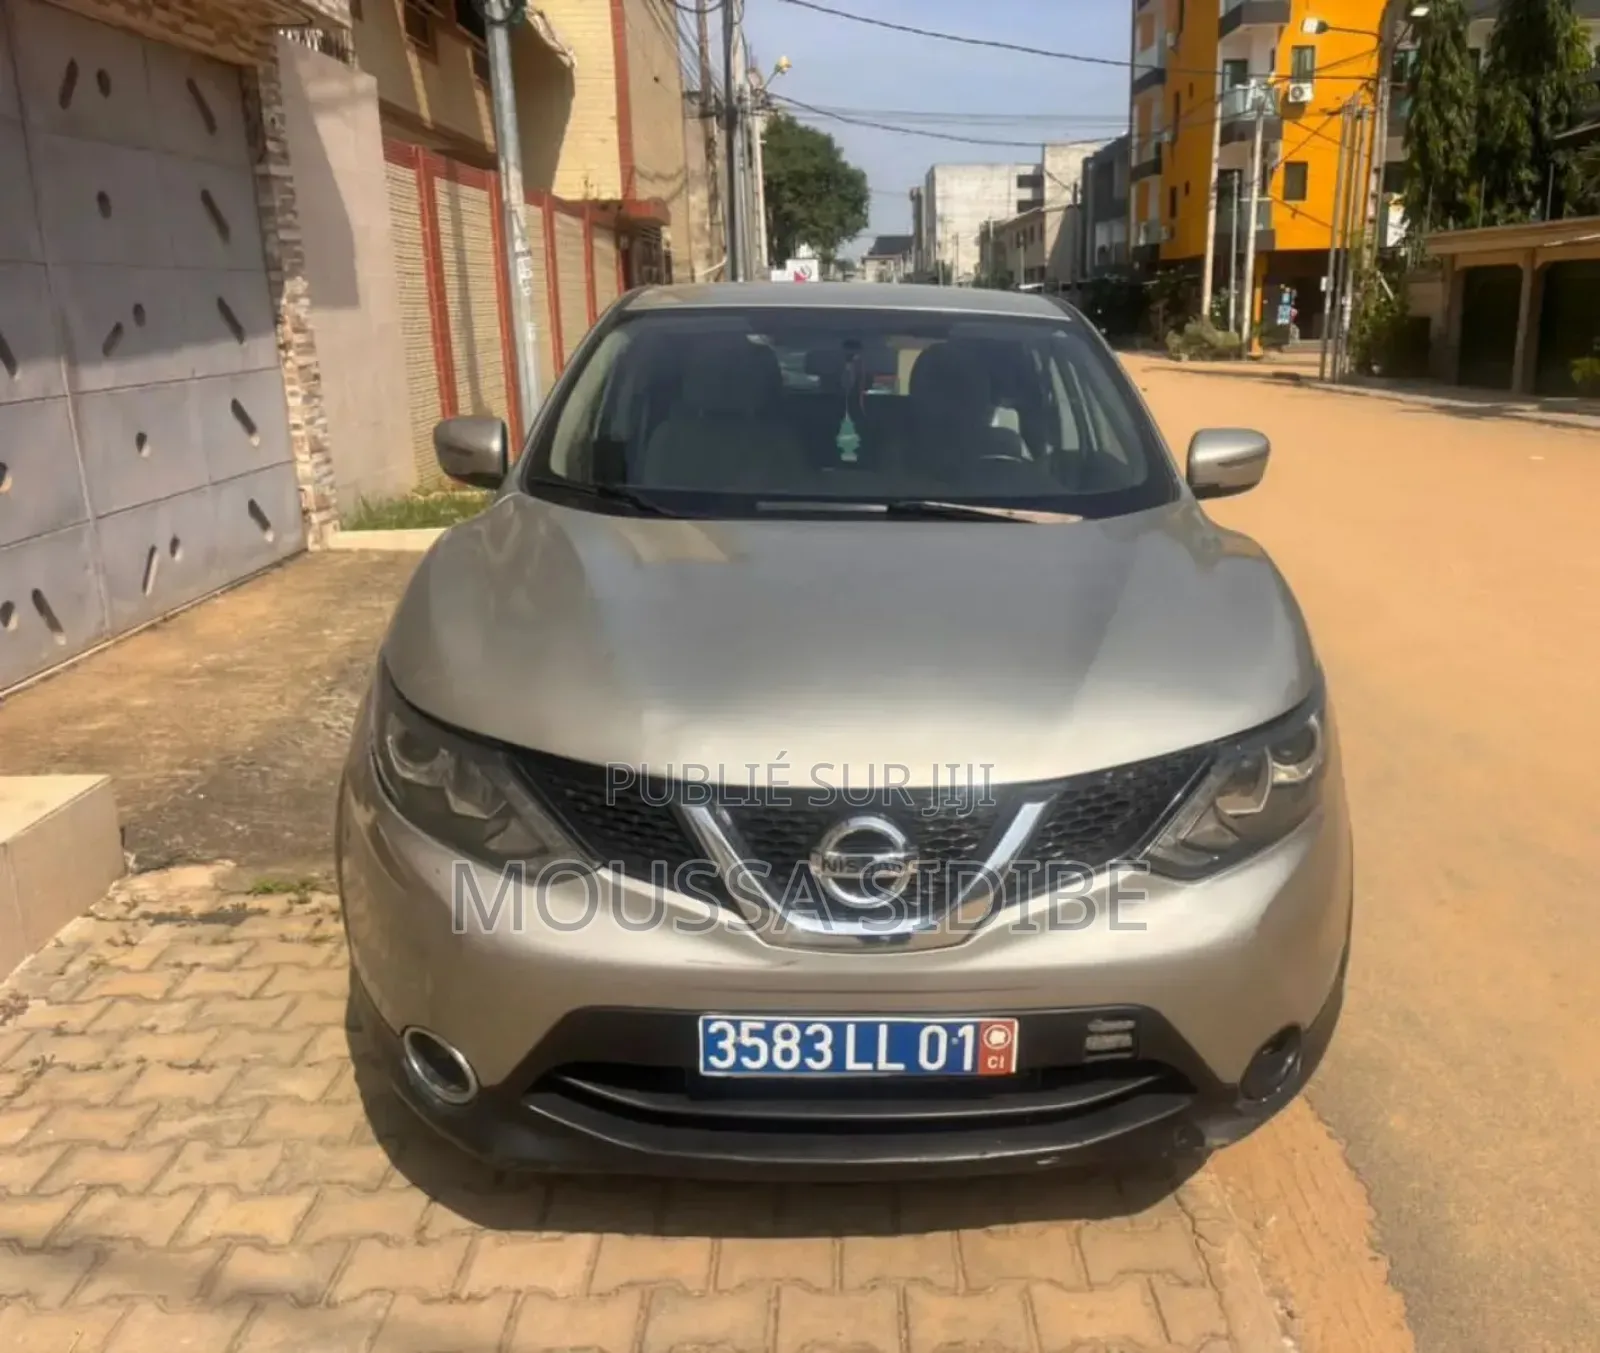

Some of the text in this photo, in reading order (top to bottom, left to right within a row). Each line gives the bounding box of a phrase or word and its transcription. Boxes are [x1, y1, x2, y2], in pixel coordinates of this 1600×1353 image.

[823, 857, 906, 874] NISN
[708, 1021, 975, 1071] 3583 LL 01
[986, 1055, 1005, 1069] CI
